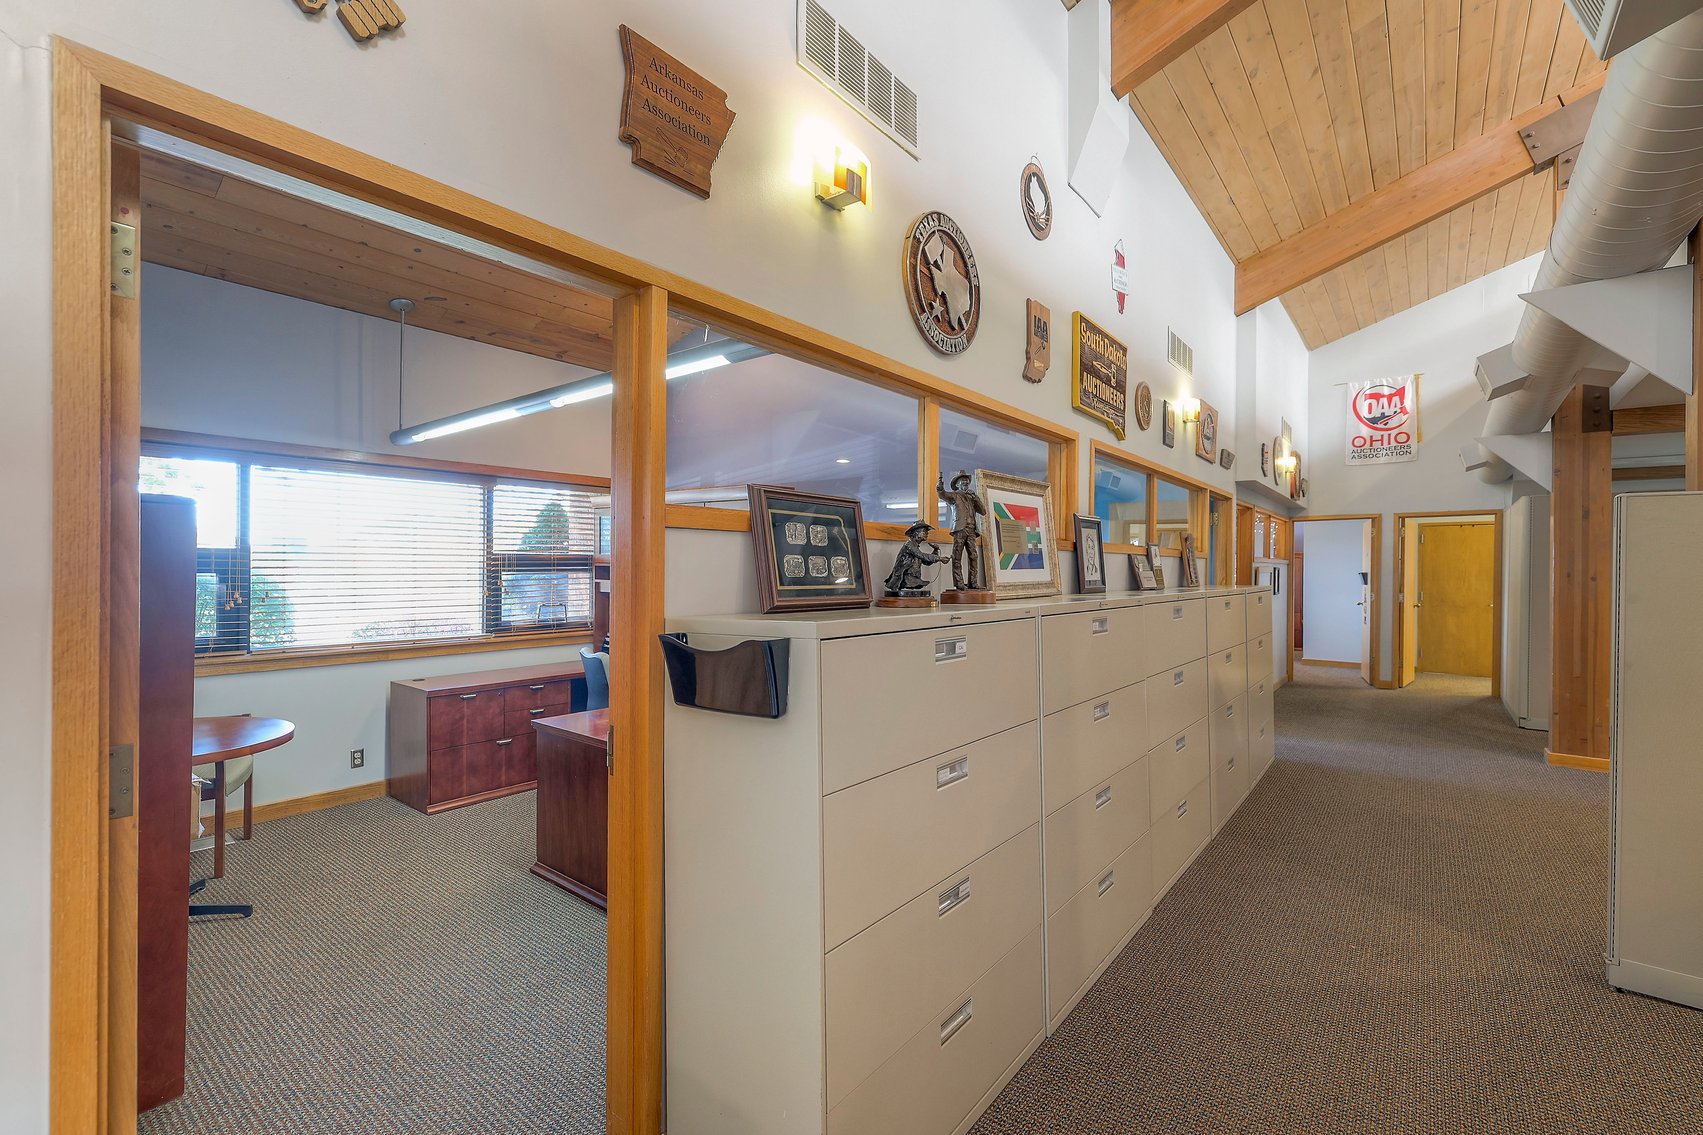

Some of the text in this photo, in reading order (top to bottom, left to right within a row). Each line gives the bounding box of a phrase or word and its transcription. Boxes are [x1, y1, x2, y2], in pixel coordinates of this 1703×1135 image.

[649, 57, 704, 101] Arkansas
[640, 74, 712, 126] Auctioneers
[642, 98, 711, 146] Association
[915, 213, 939, 242] TEXAS
[919, 312, 968, 353] ASSOCIATION
[1081, 322, 1127, 370] South Dakota
[1082, 371, 1125, 410] AUCTIONEERS
[1363, 395, 1402, 418] OAA
[1350, 449, 1412, 460] ASSOCIATION
[1351, 431, 1411, 448] OHIO
[1351, 443, 1412, 454] AUCTIONEERS
